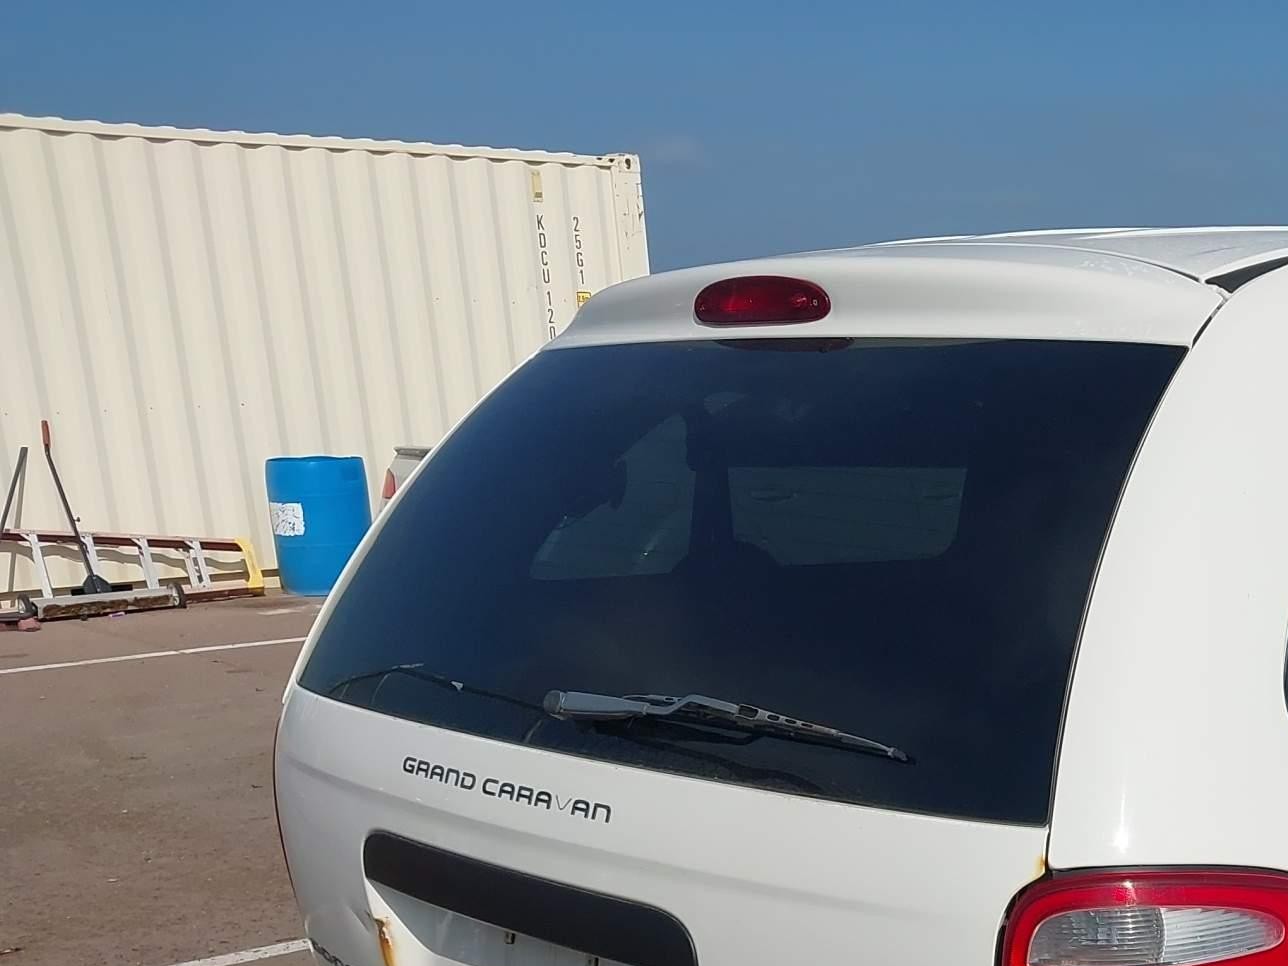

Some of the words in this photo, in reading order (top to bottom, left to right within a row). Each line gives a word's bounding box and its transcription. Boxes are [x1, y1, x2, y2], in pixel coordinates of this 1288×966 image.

[536, 214, 550, 284] KDCU
[572, 216, 585, 285] 25G1
[402, 756, 477, 791] GRAND
[481, 778, 612, 824] CARAVAN
